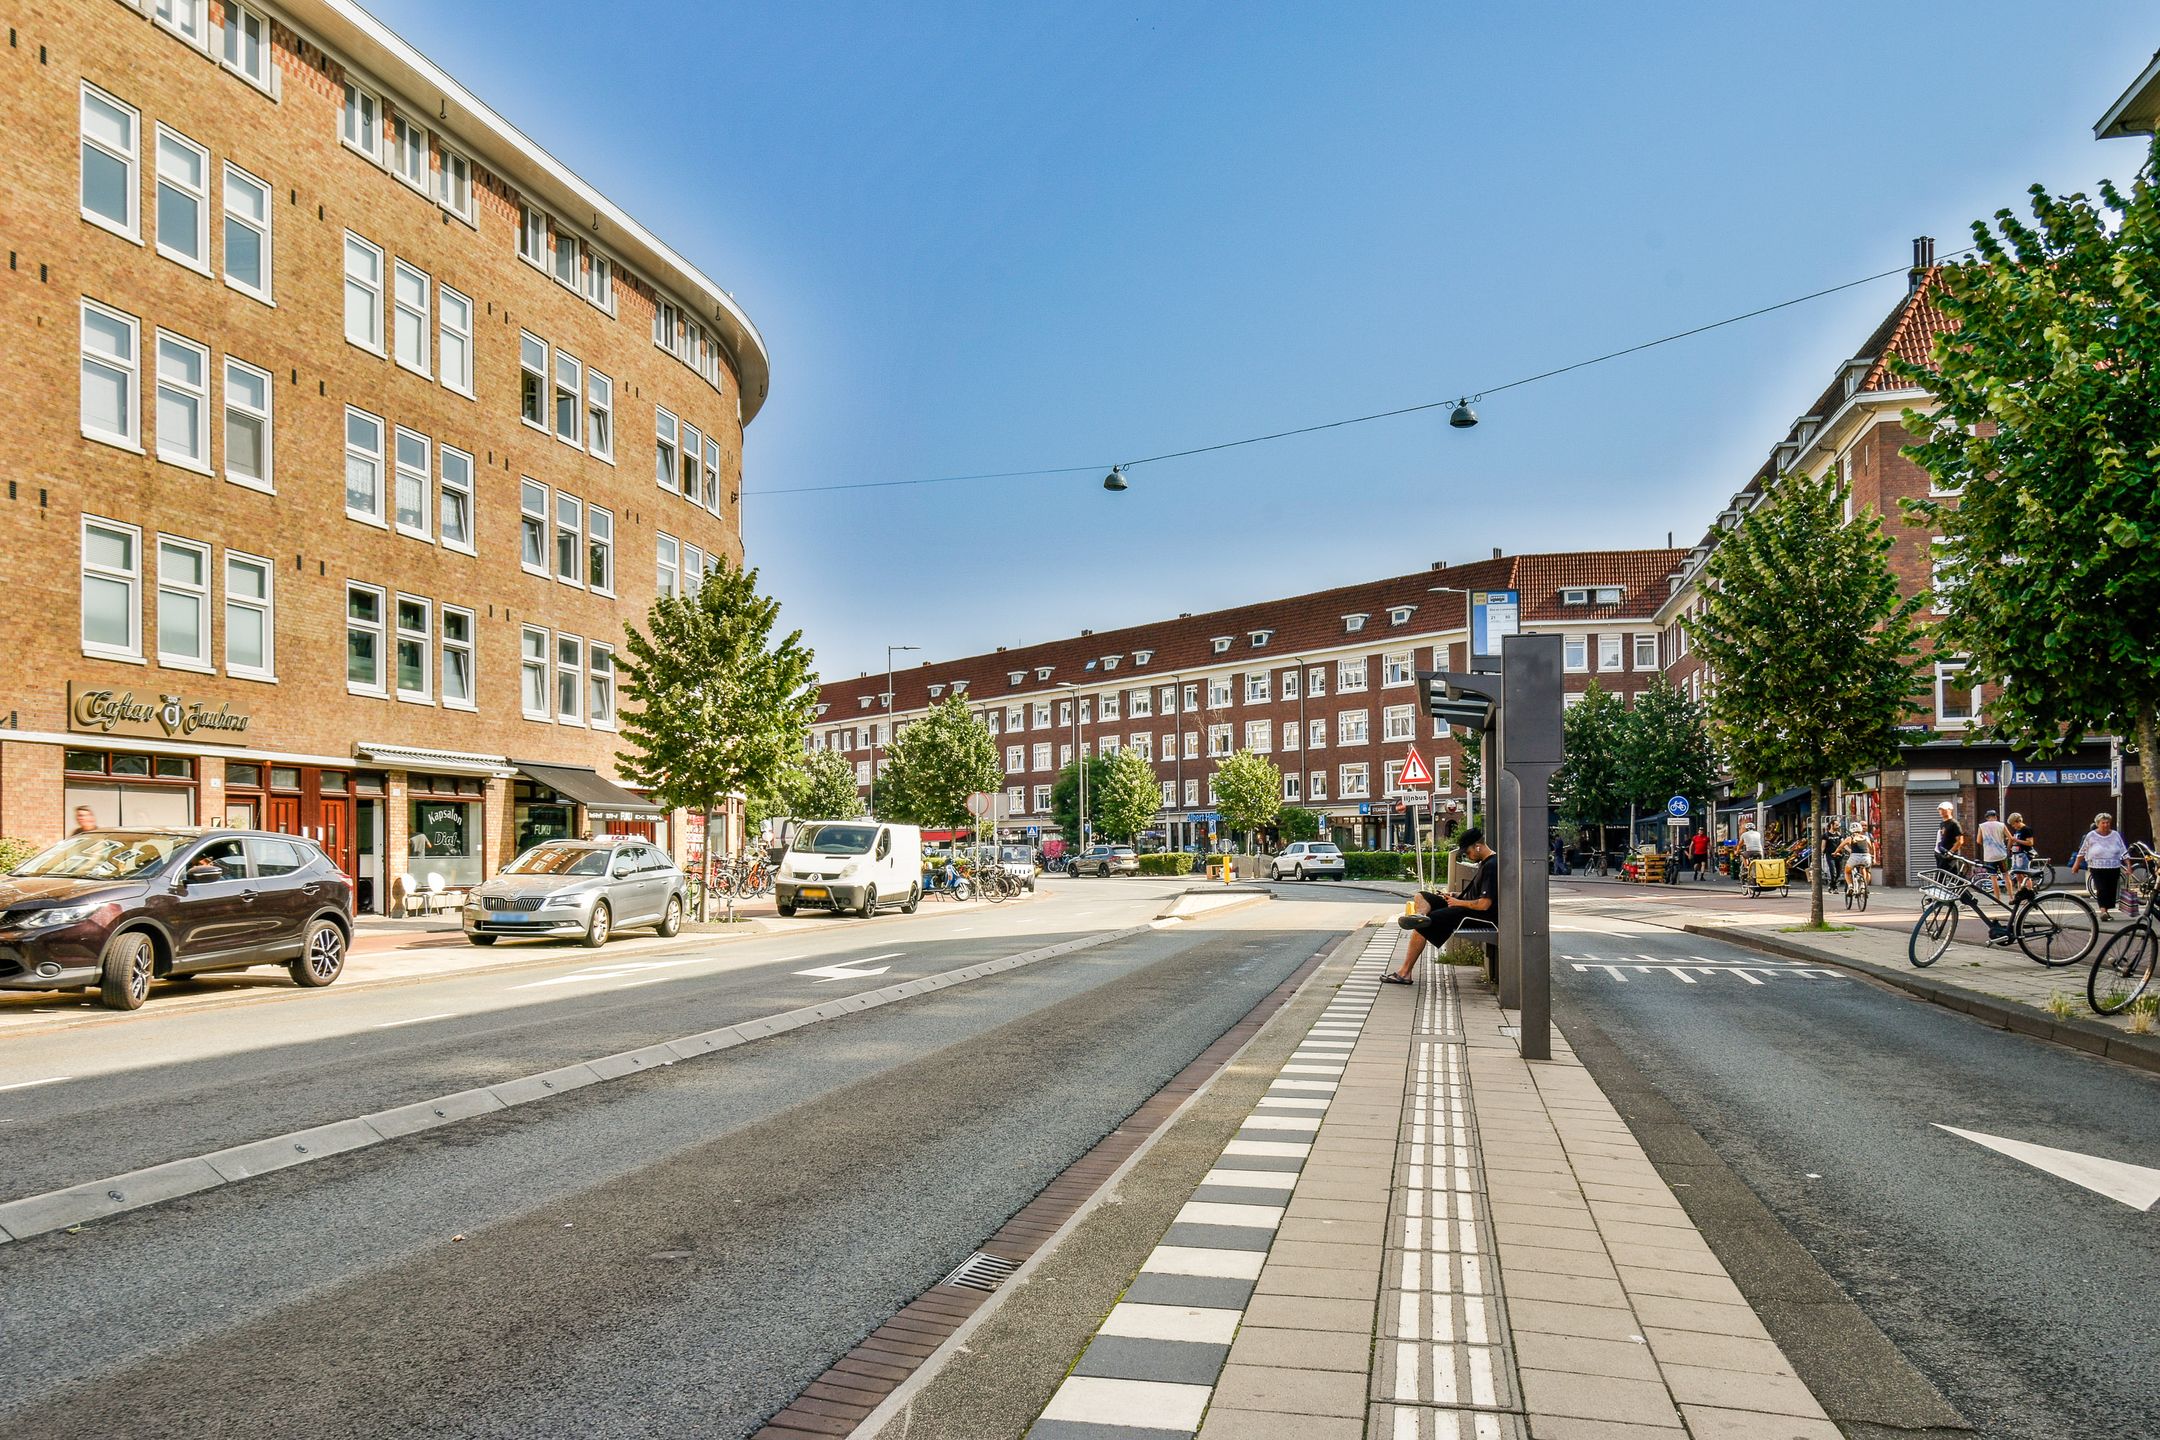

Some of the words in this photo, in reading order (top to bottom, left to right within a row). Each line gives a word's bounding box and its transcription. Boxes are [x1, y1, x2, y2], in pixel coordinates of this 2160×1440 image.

[75, 690, 154, 731] Caftan
[2012, 771, 2048, 783] ERA
[2061, 770, 2112, 781] BEYDOĞA
[428, 808, 462, 826] Kapsalon
[534, 824, 551, 835] FUKU
